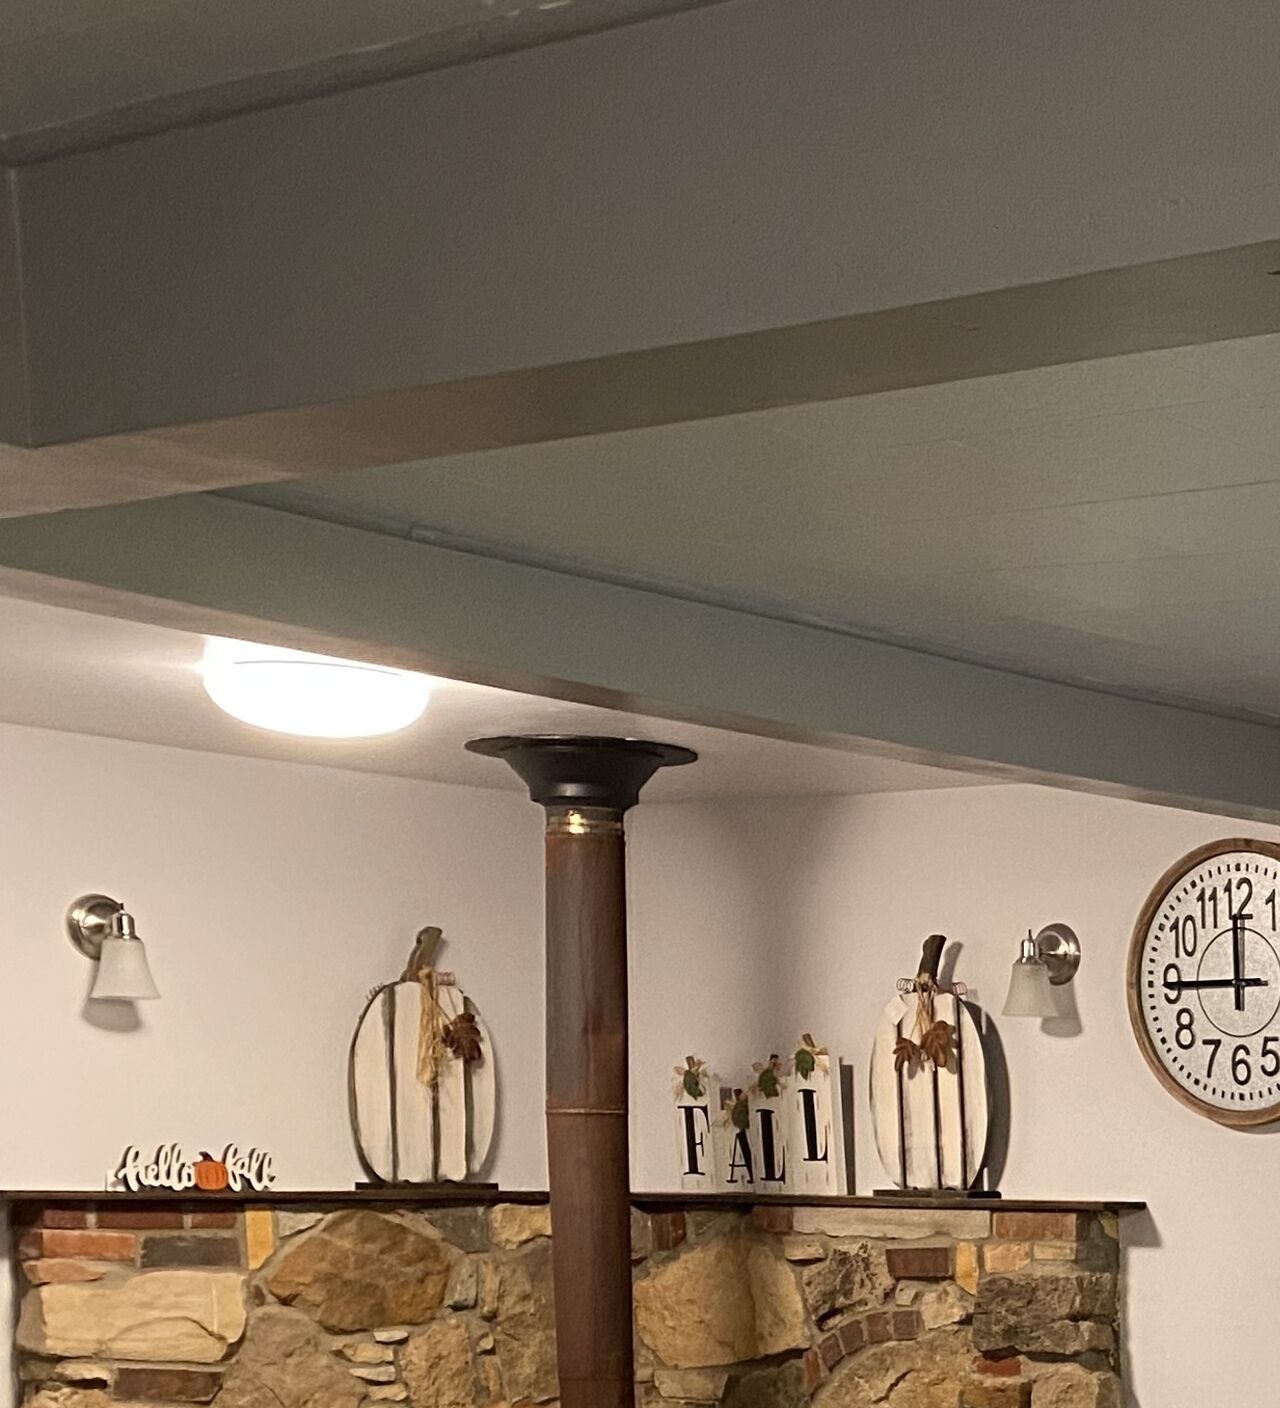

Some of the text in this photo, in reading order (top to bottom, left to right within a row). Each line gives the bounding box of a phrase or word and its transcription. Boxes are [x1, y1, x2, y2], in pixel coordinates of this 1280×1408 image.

[1196, 887, 1218, 929] 11
[1224, 877, 1253, 920] 12
[1265, 888, 1277, 932] 1
[1169, 914, 1197, 958] 10
[1163, 963, 1182, 1004] 9
[1175, 1008, 1196, 1050] 8
[1202, 1038, 1221, 1078] 7
[1231, 1044, 1250, 1085] 6
[1260, 1036, 1280, 1077] 5
[677, 1088, 829, 1185] FALL
[116, 1143, 277, 1191] hello fall
